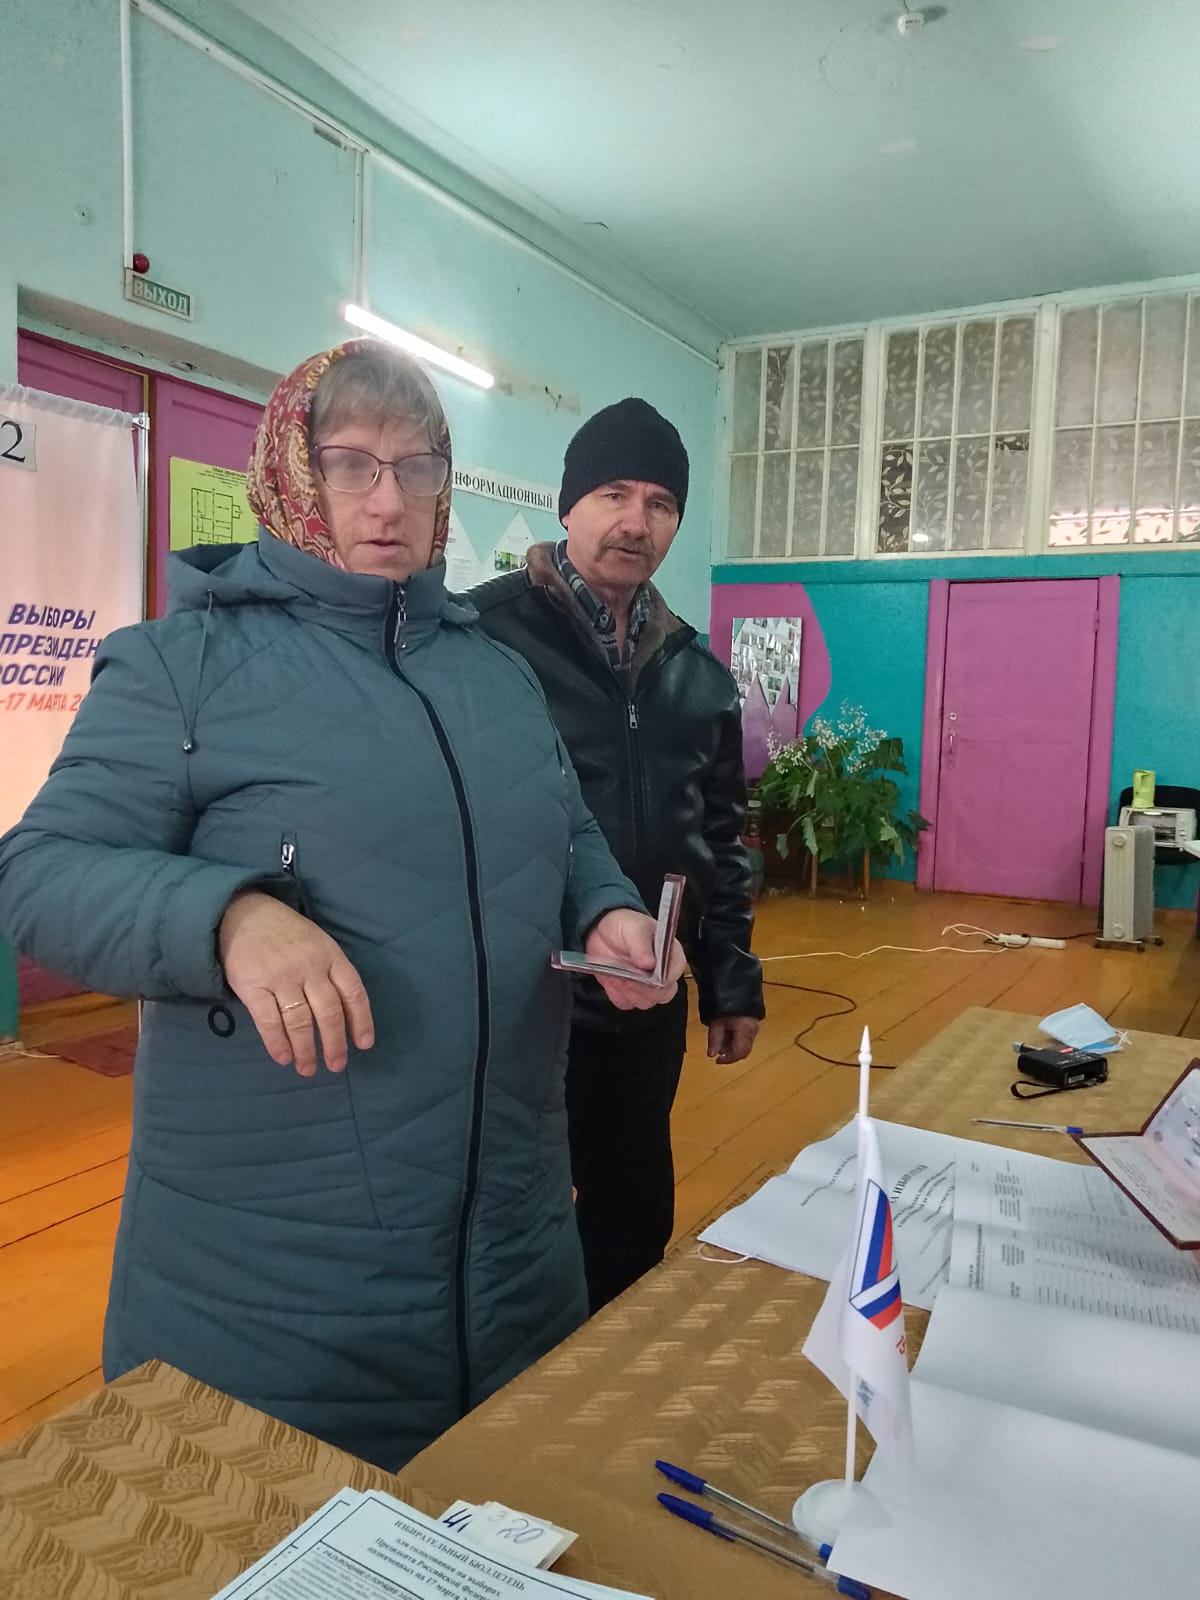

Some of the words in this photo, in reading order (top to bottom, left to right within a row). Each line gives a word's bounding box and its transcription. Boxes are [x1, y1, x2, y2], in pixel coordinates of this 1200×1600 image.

[134, 280, 188, 314] ВЫХОД
[8, 603, 96, 630] ВЫБОРЫ
[26, 693, 68, 712] МАРТА
[375, 1537, 417, 1564] Президента
[416, 1559, 461, 1588] Российской
[394, 1520, 469, 1563] ИЗБИРАТЕЛЬНЫЙ
[469, 1559, 525, 1591] БЮЛЛЕТЕНЬ
[426, 1576, 438, 1586] 17
[468, 1576, 500, 1597] выборах
